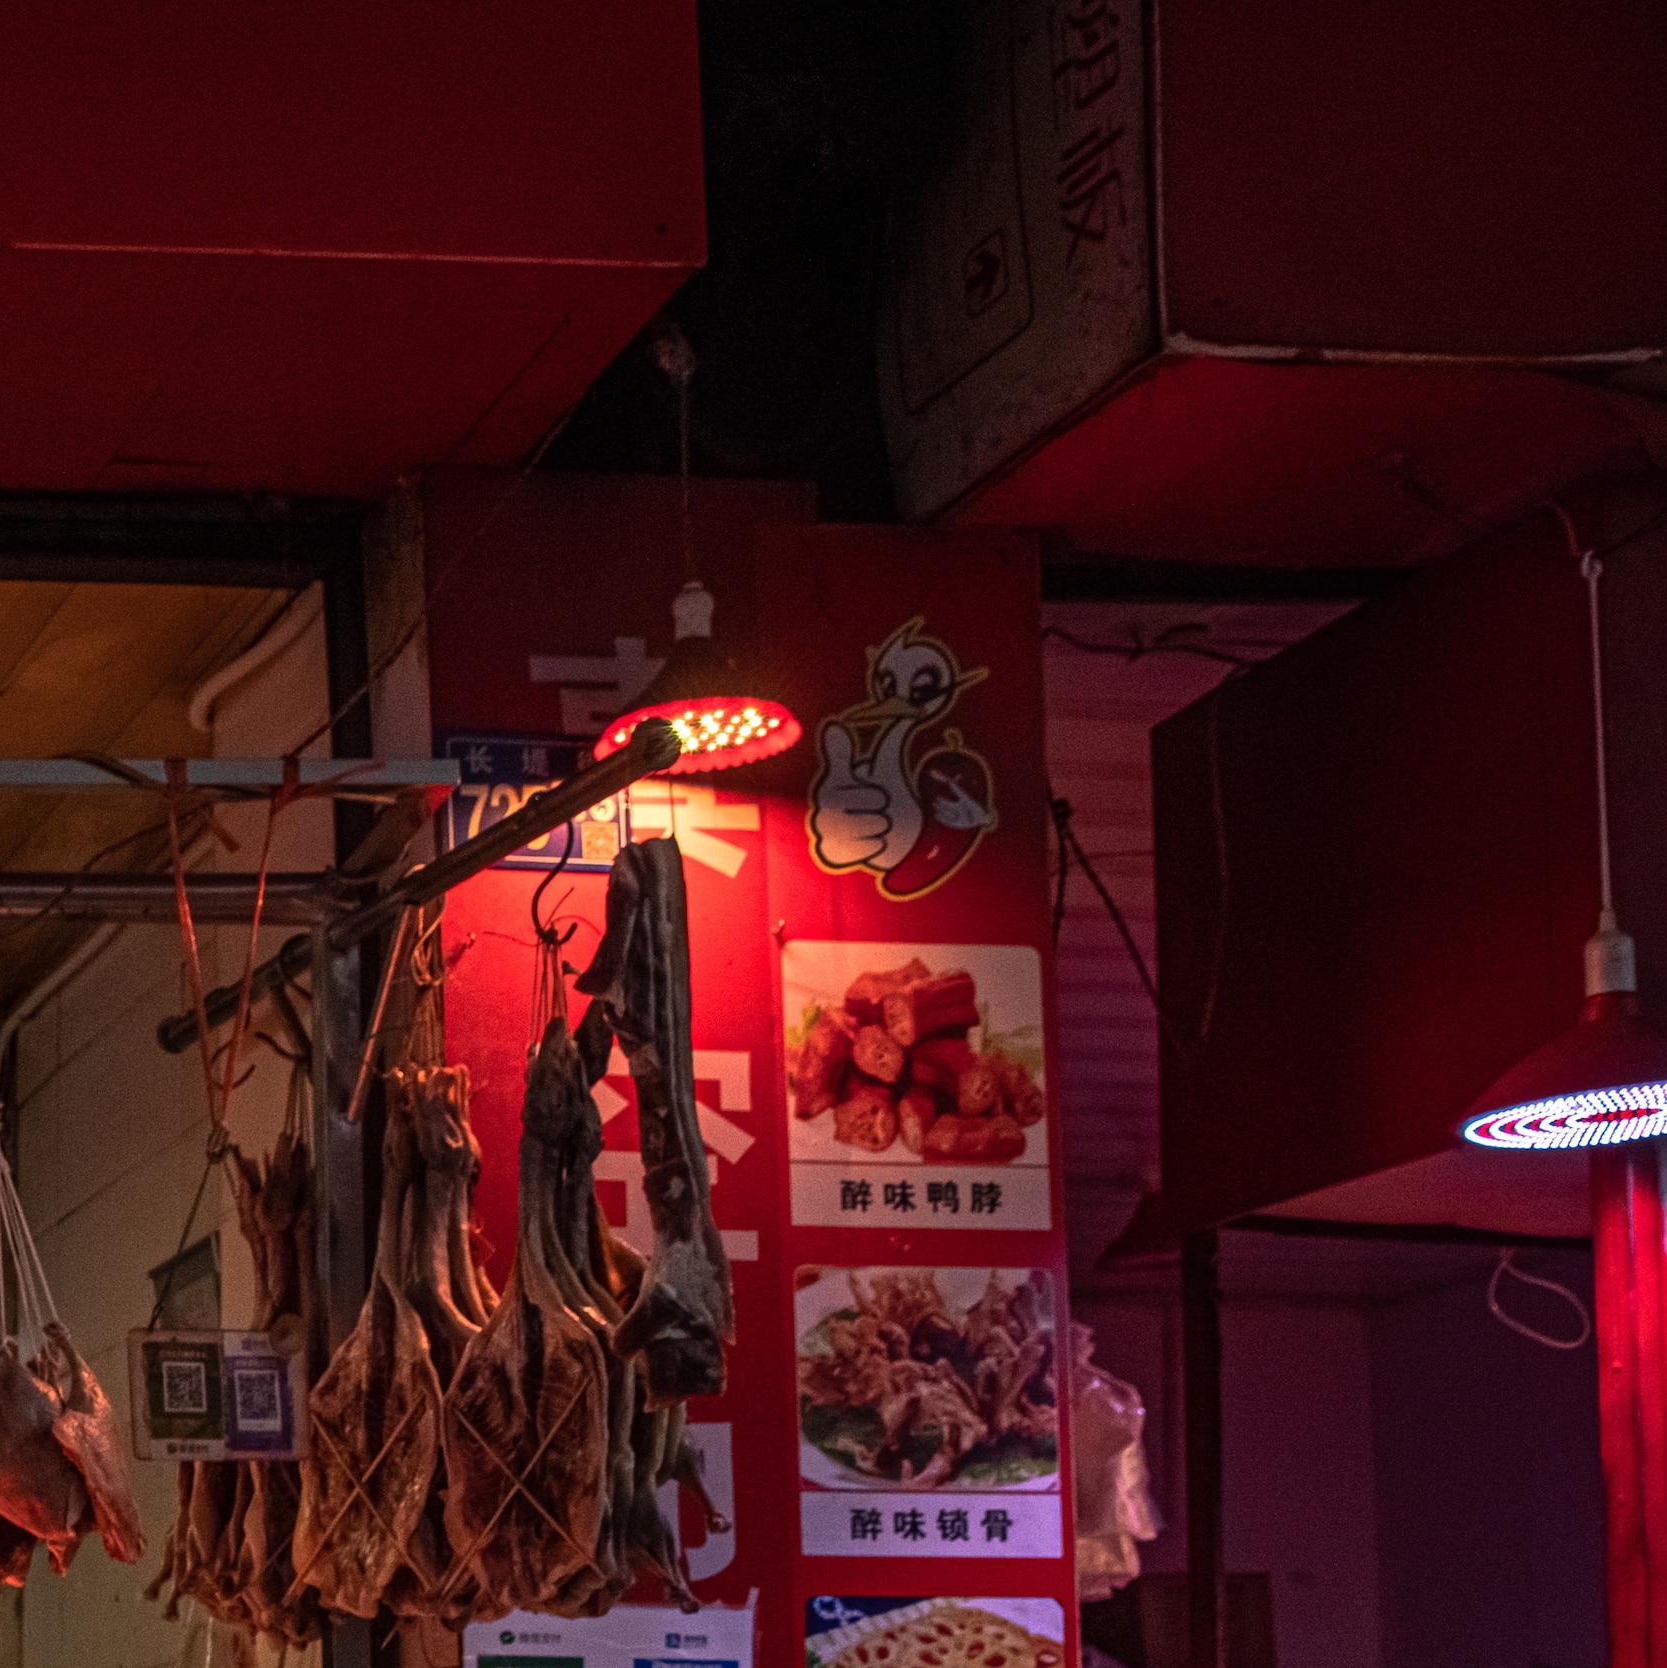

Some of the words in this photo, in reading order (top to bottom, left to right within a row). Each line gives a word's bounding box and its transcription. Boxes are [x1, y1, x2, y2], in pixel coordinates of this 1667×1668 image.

[840, 1180, 1003, 1214] 醉味鸭脖
[850, 1509, 1013, 1542] 醉味锁骨
